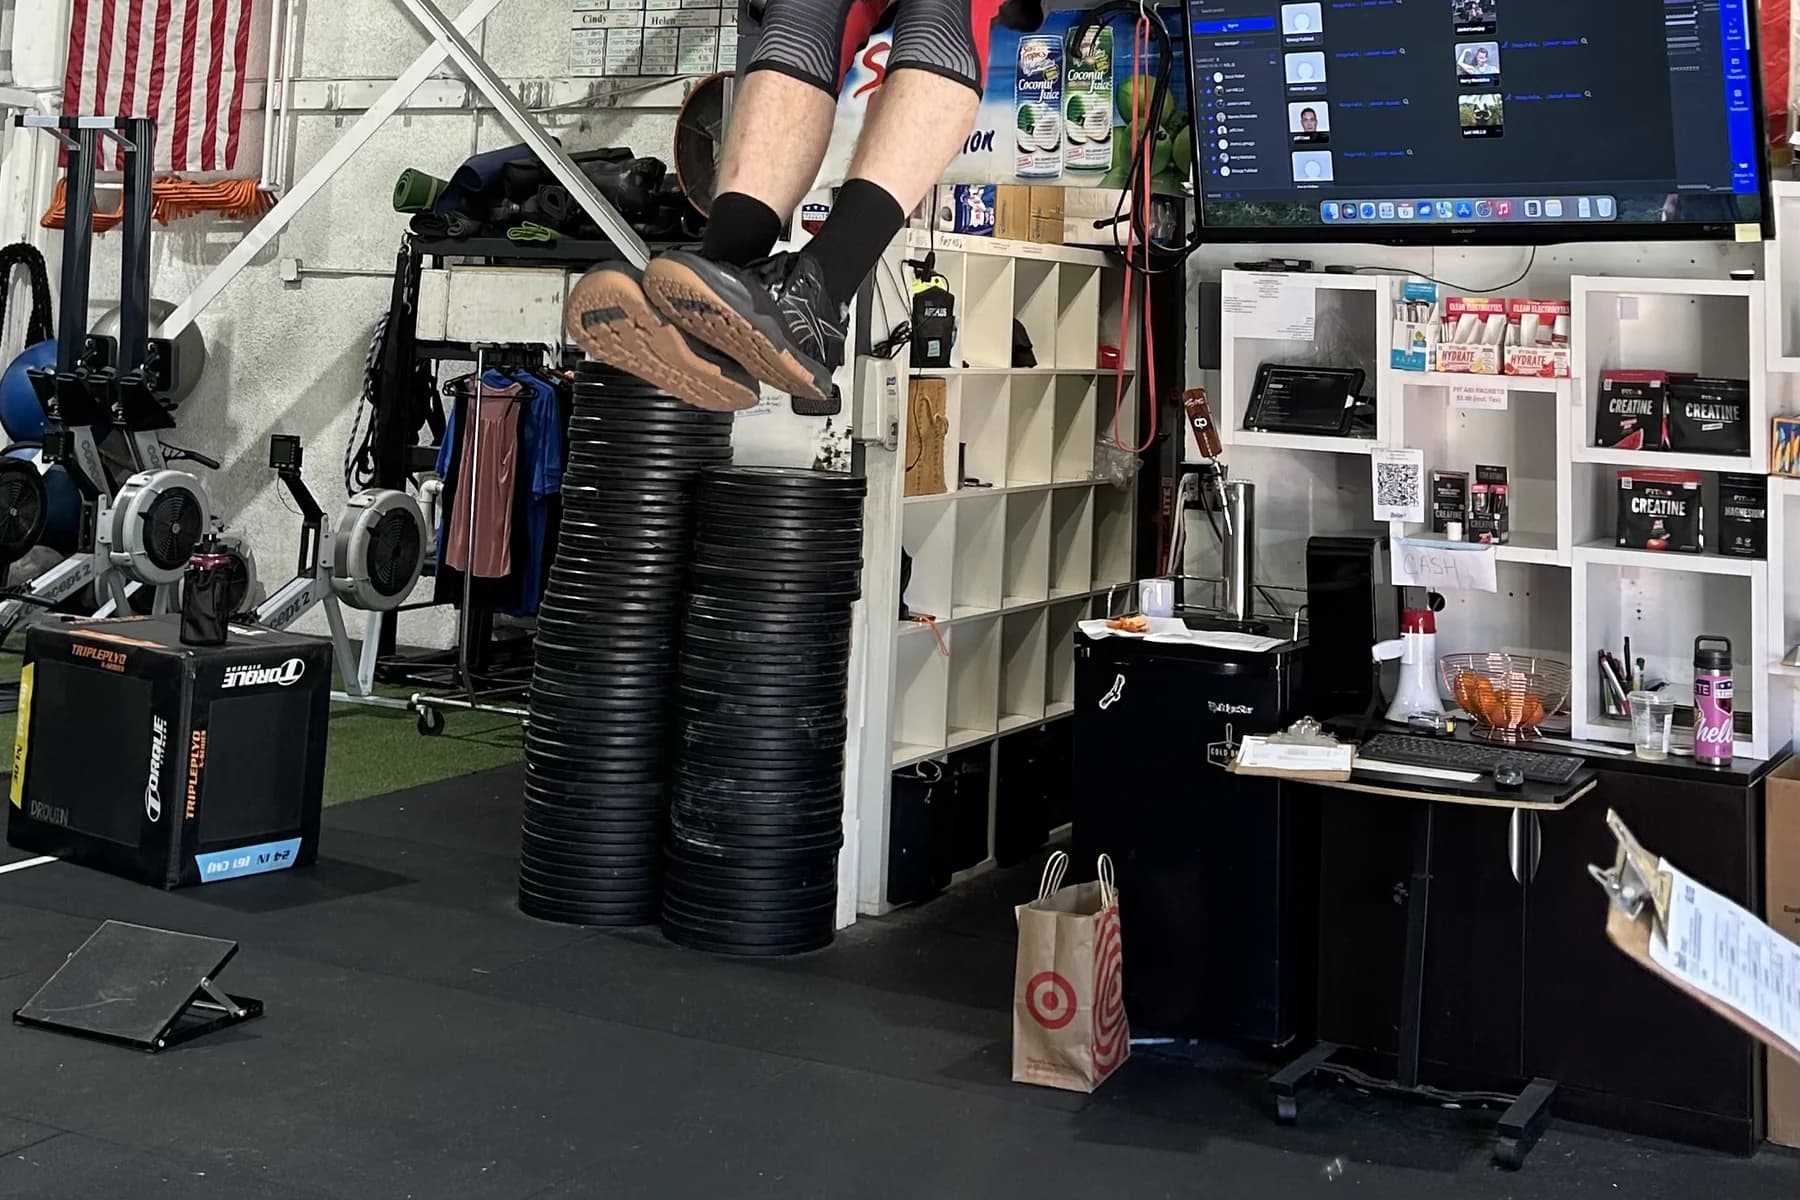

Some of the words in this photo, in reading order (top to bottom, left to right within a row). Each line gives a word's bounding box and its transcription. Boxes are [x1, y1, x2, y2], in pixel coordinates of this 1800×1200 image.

[582, 14, 608, 25] Cindy
[651, 15, 676, 25] Helen
[1067, 69, 1104, 81] Coconut
[1018, 78, 1054, 91] Coconut
[1089, 79, 1110, 94] Juice
[1039, 89, 1060, 102] Juice
[1441, 351, 1475, 362] HYDRATE
[1511, 355, 1546, 365] HYDRATE
[1609, 398, 1653, 415] CREATINE
[1685, 403, 1741, 420] CREATINE
[1631, 498, 1687, 516] CREATINE
[1725, 506, 1765, 519] MAGNESIUM
[1435, 511, 1462, 519] CREATINE
[1403, 552, 1459, 580] CASH
[302, 591, 310, 605] 2
[72, 643, 127, 665] TRIPLEPLYO
[222, 658, 305, 688] TORQUE
[145, 715, 165, 822] TORQUE
[186, 730, 202, 820] TRIPLEPLYO
[30, 800, 69, 826] DROUIN
[256, 853, 270, 864] IN
[274, 850, 290, 862] 24
